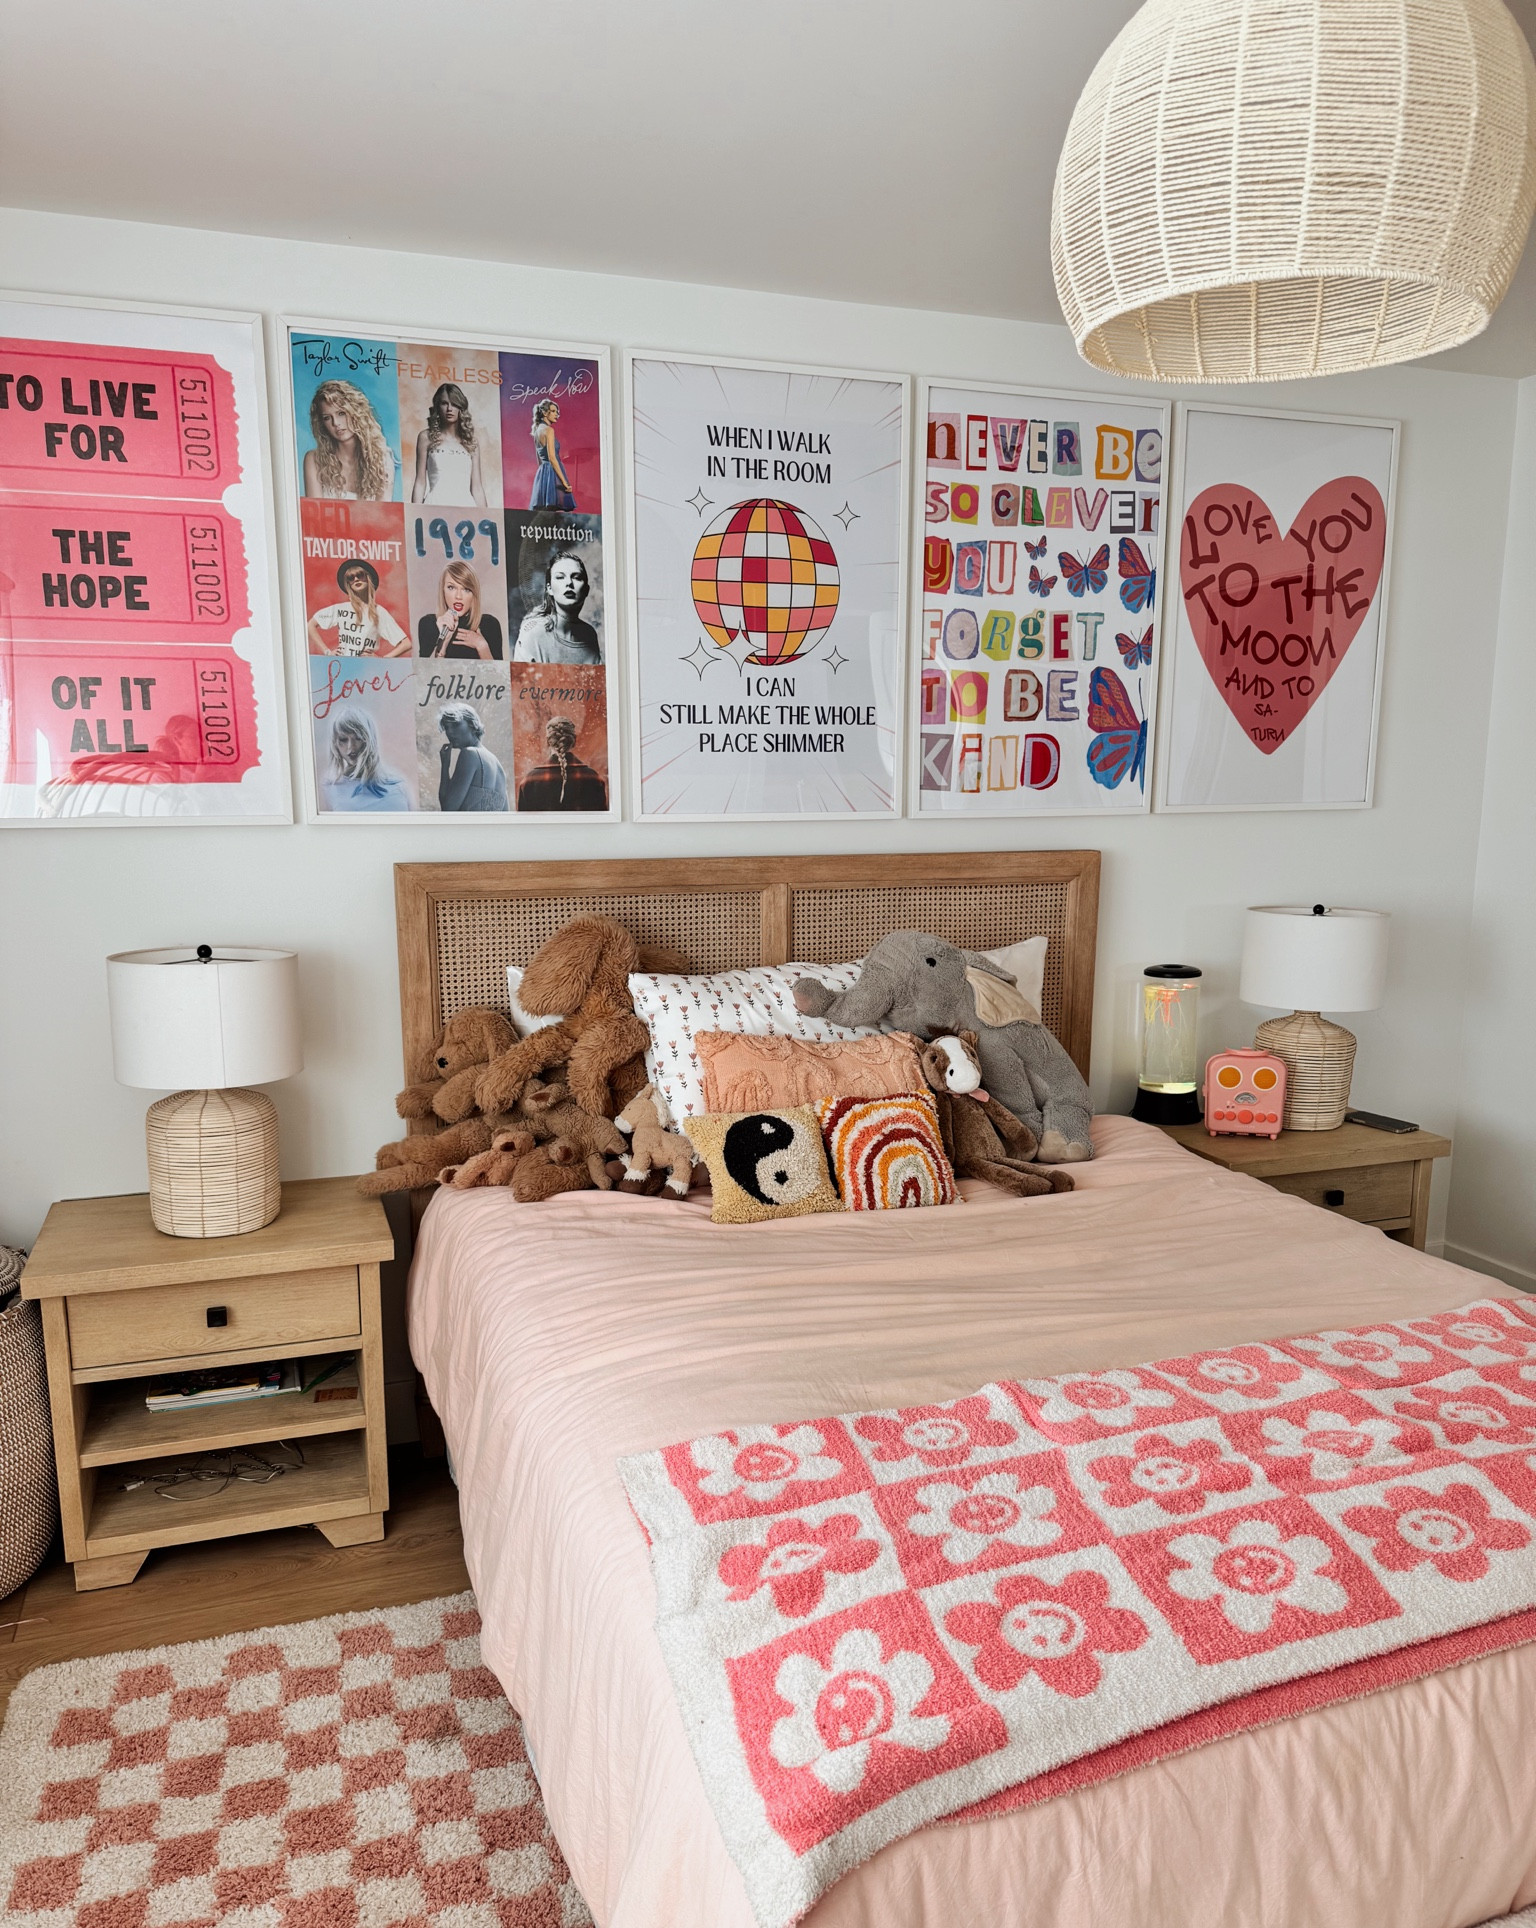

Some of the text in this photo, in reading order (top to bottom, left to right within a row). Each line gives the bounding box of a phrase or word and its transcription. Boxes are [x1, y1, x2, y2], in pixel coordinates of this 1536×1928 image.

[292, 339, 403, 377] Taylor Swift
[397, 362, 504, 386] FEARLESS
[61, 377, 158, 420] LIVE
[509, 368, 594, 404] Speak Now
[44, 422, 128, 462] FOR
[179, 377, 215, 472] 511002
[706, 425, 832, 455] WHEN I WALK
[707, 456, 832, 484] IN THE ROOM
[301, 501, 351, 537] RED
[925, 481, 980, 523] SO
[52, 529, 133, 567] THE
[303, 537, 402, 561] TAYLOR SWIFT
[415, 517, 500, 565] 1989
[520, 523, 594, 543] reputation
[1185, 492, 1373, 570] LOVE YOU
[190, 527, 225, 617] 511002
[42, 573, 150, 611] HOPE
[1184, 562, 1370, 626] TO THE
[343, 621, 365, 633] LOT
[1219, 619, 1337, 667] MOON
[51, 676, 156, 711] OF IT
[312, 659, 416, 719] Lover
[419, 674, 506, 706] folklore
[519, 684, 603, 702] evermore
[746, 677, 796, 697] I CAN
[921, 669, 1080, 722] TO BE
[1224, 667, 1315, 700] AND TO
[199, 669, 235, 759] 511002
[660, 704, 877, 726] STILL MAKE THE WHOLE
[70, 718, 149, 754] ALL
[699, 732, 845, 754] PLACE SHIMMER
[1250, 726, 1285, 743] TURN
